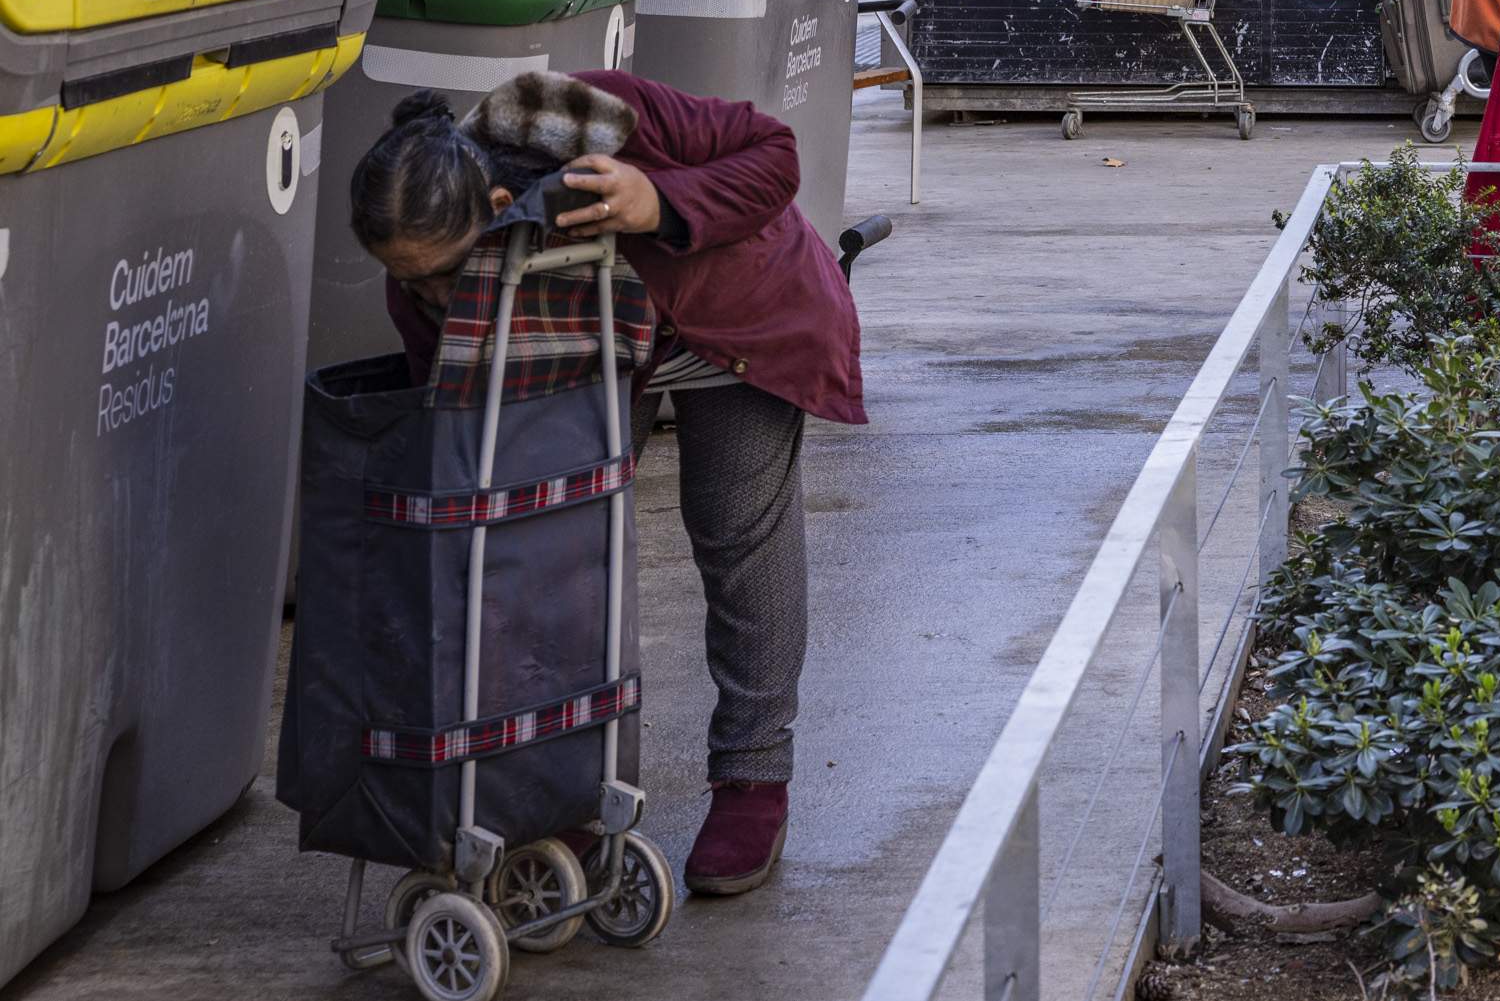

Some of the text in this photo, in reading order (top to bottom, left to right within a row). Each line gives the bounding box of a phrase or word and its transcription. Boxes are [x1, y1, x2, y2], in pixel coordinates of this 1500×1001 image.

[789, 14, 818, 47] Cuidem
[785, 44, 822, 80] Barcelona
[781, 79, 809, 112] Residus
[110, 246, 194, 312] Cuidem
[102, 298, 210, 375] Barcelona
[97, 362, 176, 437] Residus
